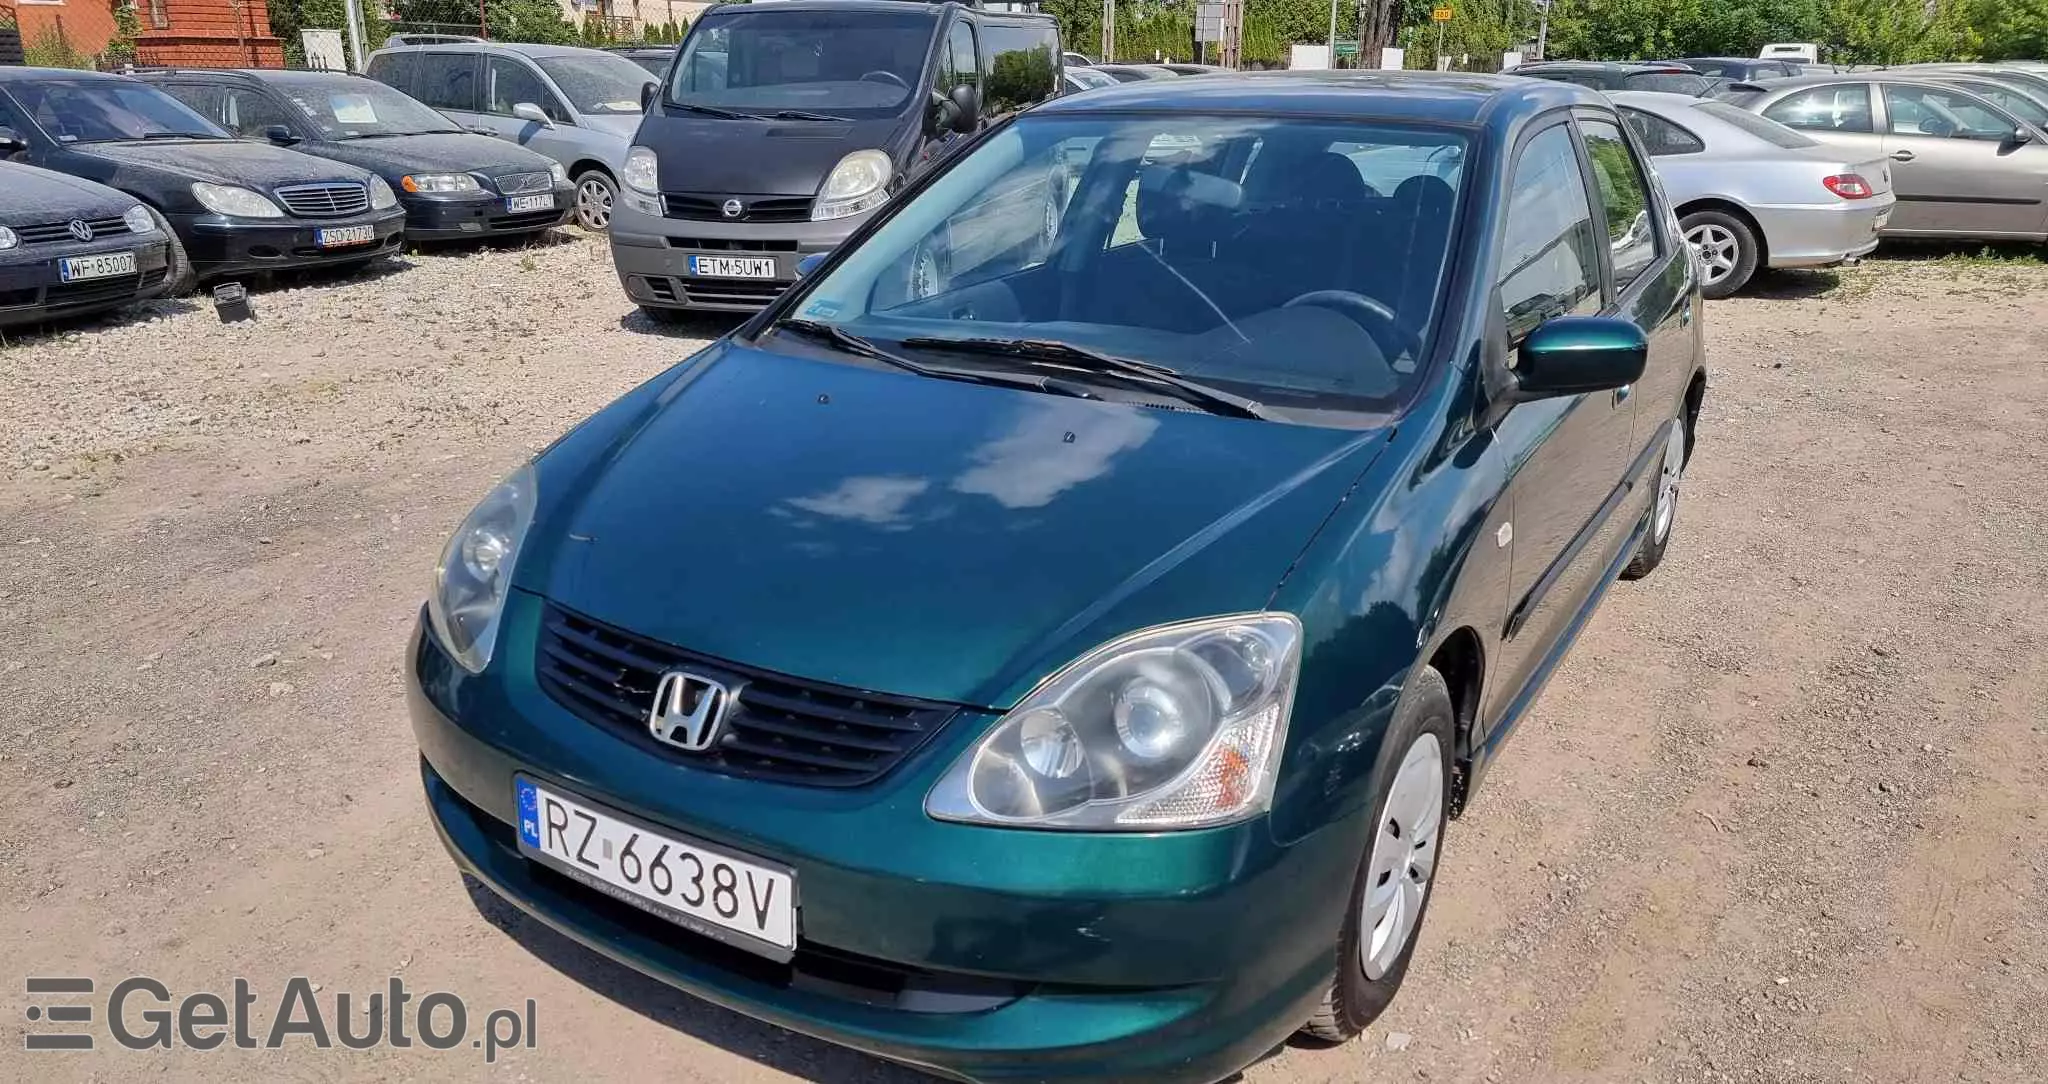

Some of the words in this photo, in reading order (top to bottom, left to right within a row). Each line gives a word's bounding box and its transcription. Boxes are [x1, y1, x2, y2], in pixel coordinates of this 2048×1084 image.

[322, 230, 343, 244] ZSD
[70, 259, 90, 278] WF
[96, 255, 132, 274] 85007
[698, 258, 730, 275] ETM
[734, 260, 771, 276] 5UW1
[523, 819, 539, 839] PL
[545, 797, 600, 871] RZ
[619, 833, 775, 931] 6638V
